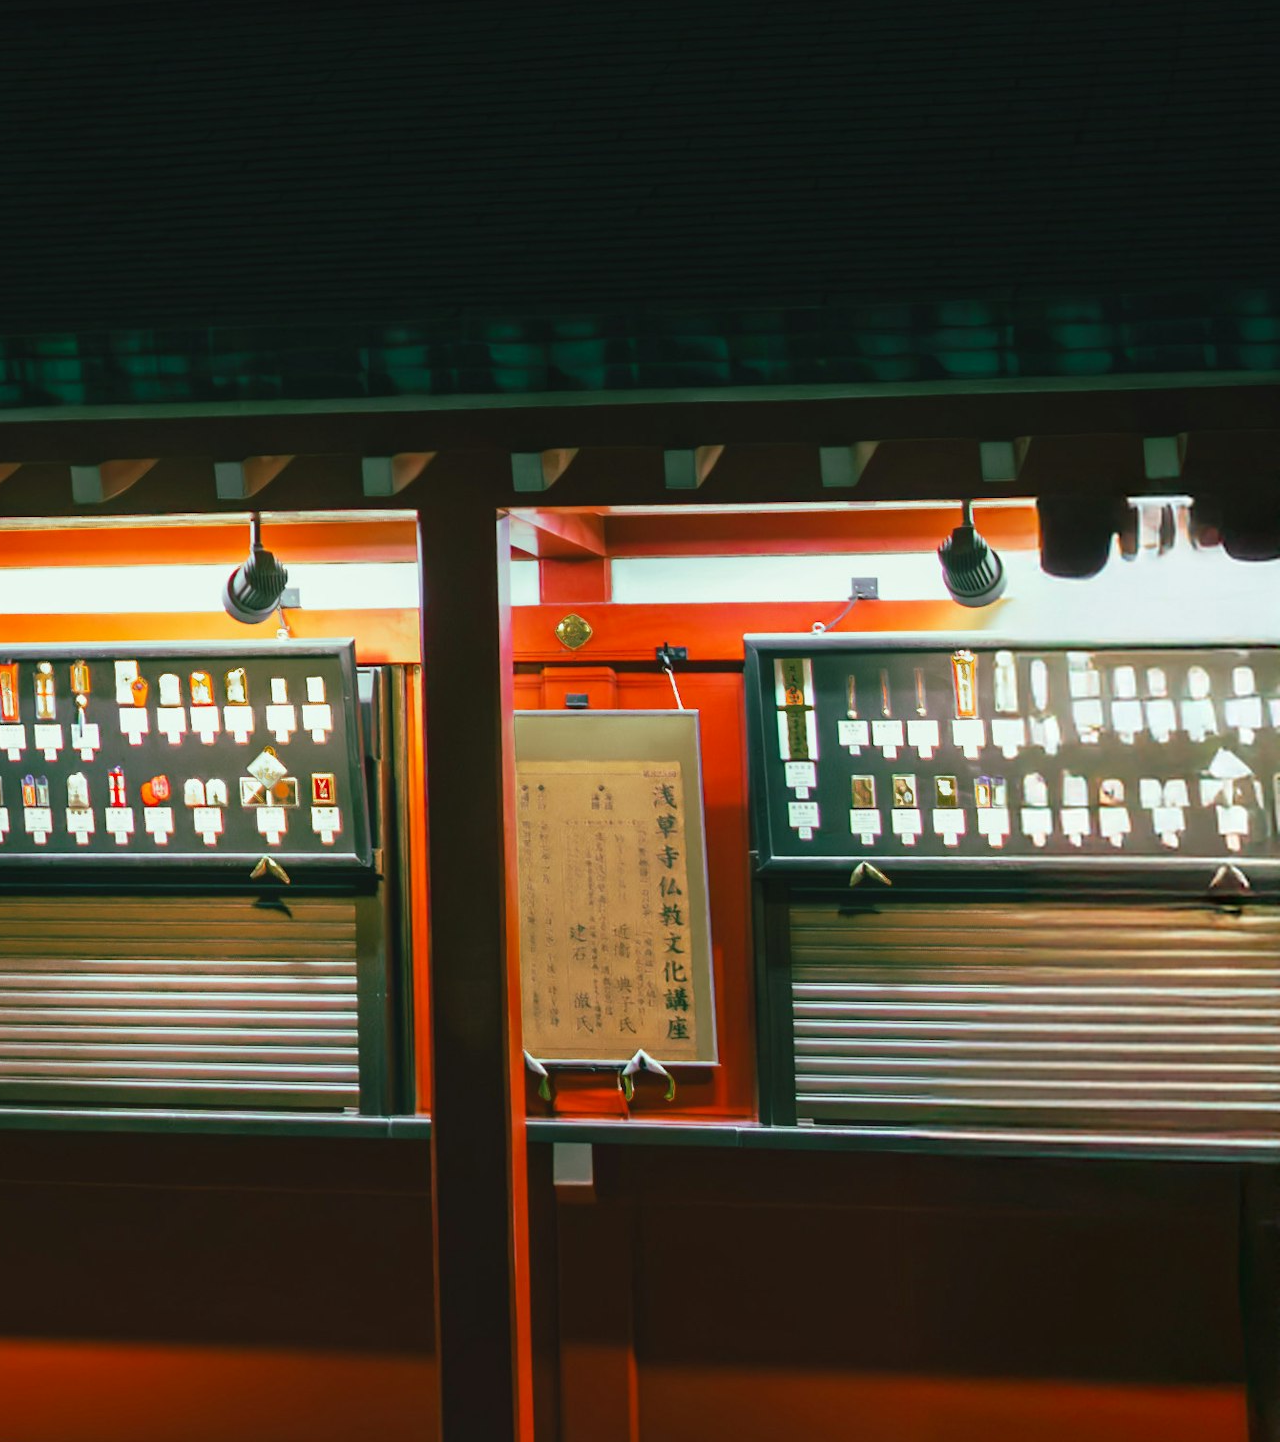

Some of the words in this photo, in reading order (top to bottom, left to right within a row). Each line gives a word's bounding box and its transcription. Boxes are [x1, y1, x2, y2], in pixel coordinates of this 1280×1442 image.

[652, 783, 690, 1041] 浅草寺仏教文化講座
